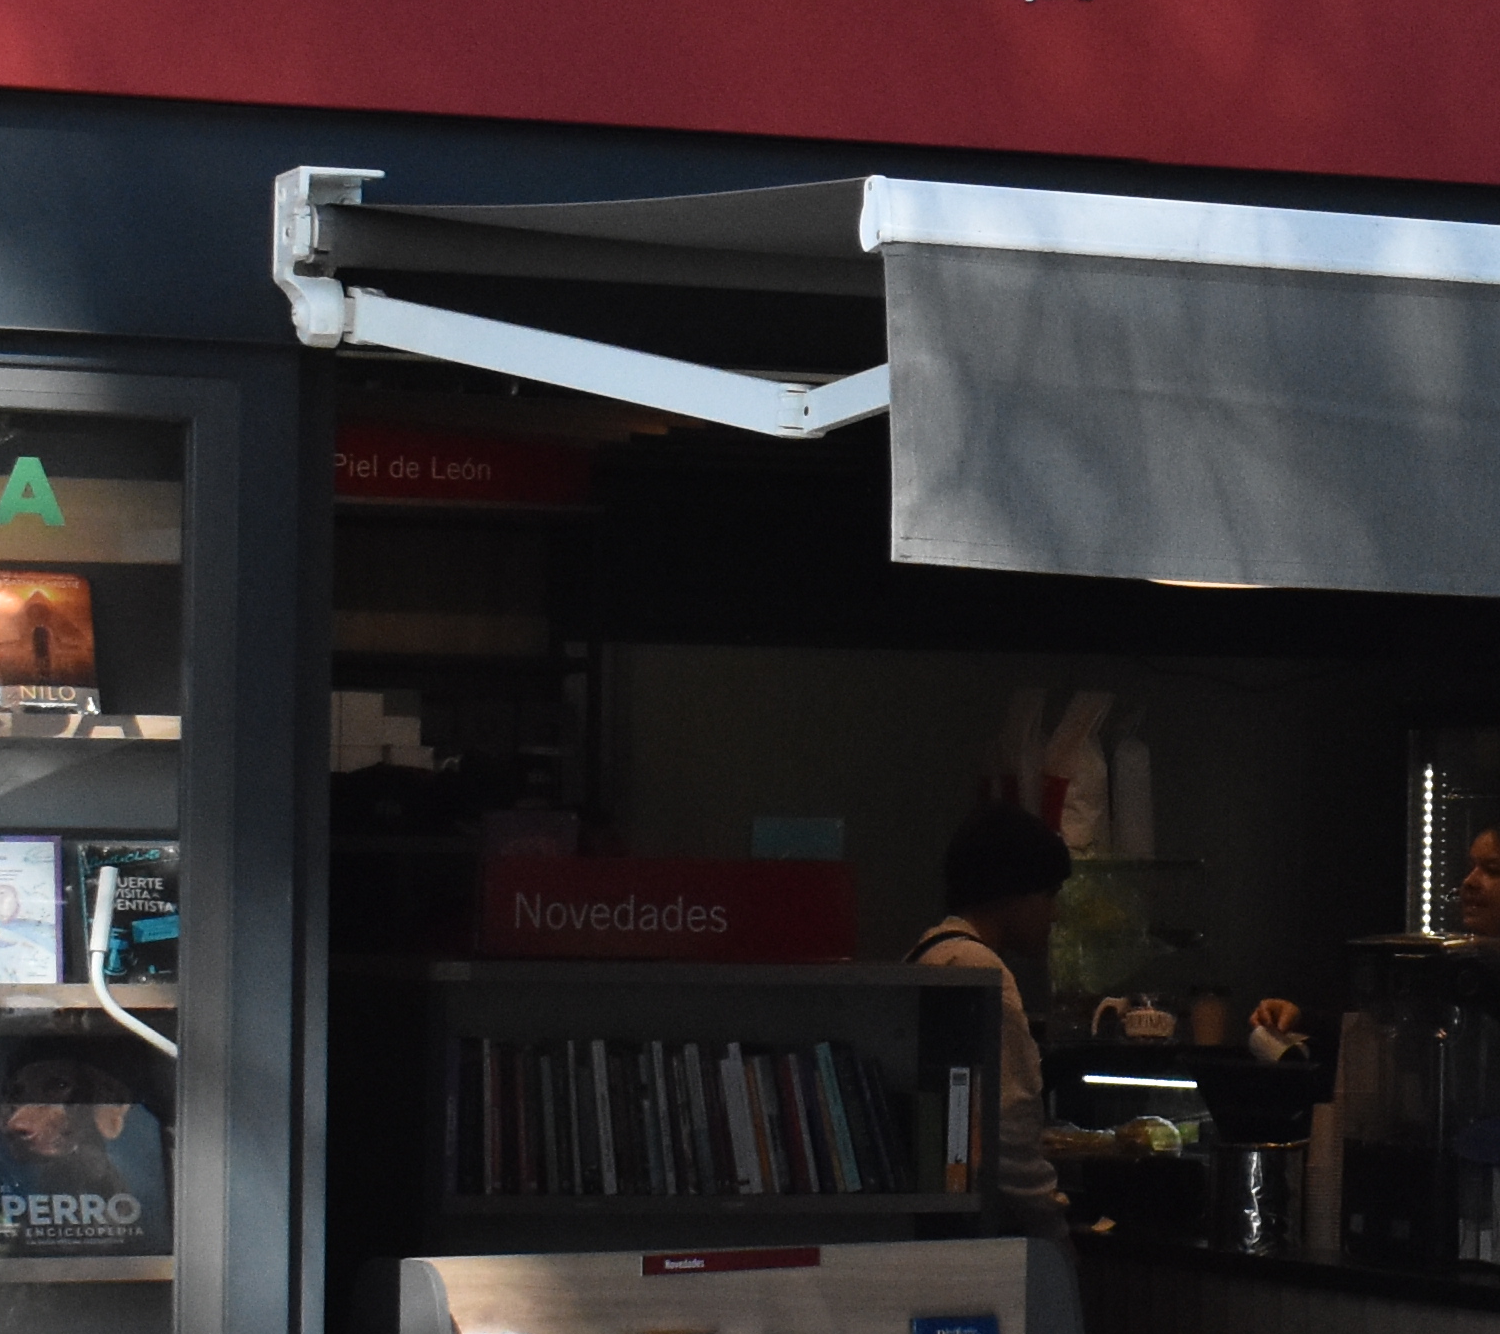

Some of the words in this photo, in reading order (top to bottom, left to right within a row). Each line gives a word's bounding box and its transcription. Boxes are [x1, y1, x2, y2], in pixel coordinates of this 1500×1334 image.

[389, 455, 420, 479] de
[431, 456, 491, 481] León
[20, 685, 76, 701] NILO
[116, 876, 164, 890] UERTE
[114, 898, 177, 913] ENTISTA
[514, 891, 728, 933] Novedades
[0, 1192, 142, 1226] PERRO
